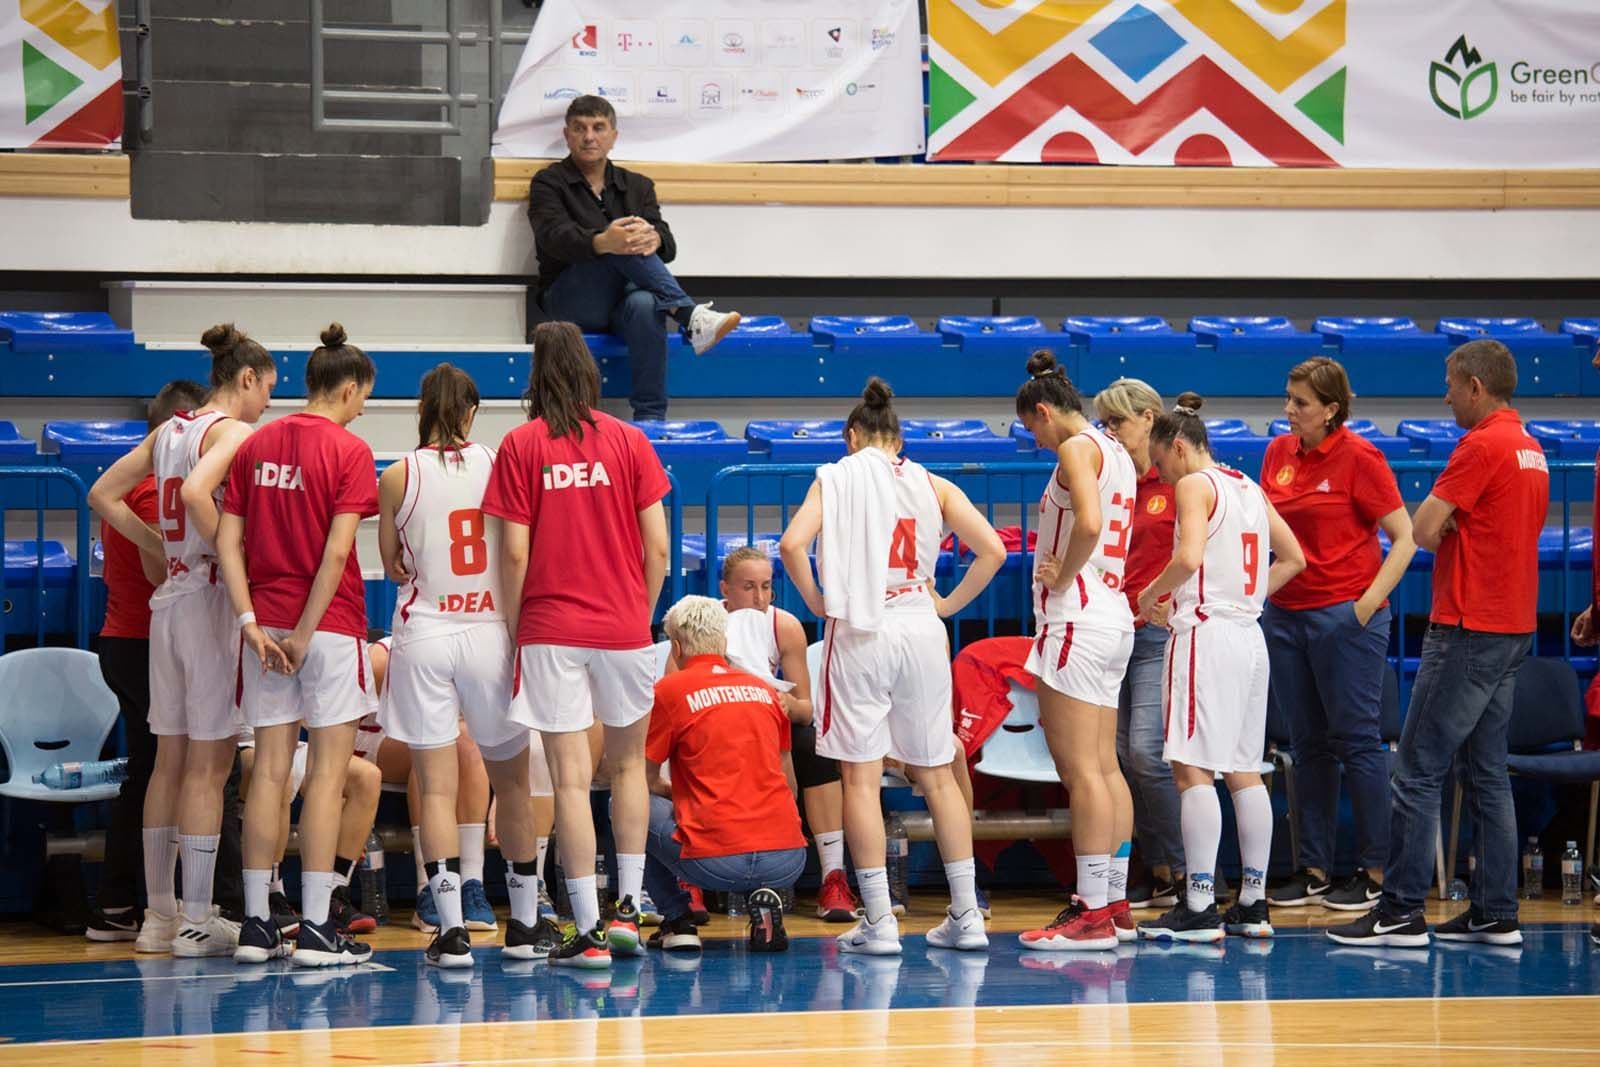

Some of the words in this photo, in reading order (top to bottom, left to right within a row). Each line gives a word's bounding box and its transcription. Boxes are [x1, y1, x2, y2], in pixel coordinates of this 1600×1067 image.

[1510, 89, 1527, 103] be
[1532, 89, 1554, 103] fair
[1559, 89, 1575, 107] by
[448, 508, 488, 576] 8
[888, 518, 918, 579] 4
[1241, 533, 1259, 596] 9
[686, 685, 773, 713] MONTENEGRO
